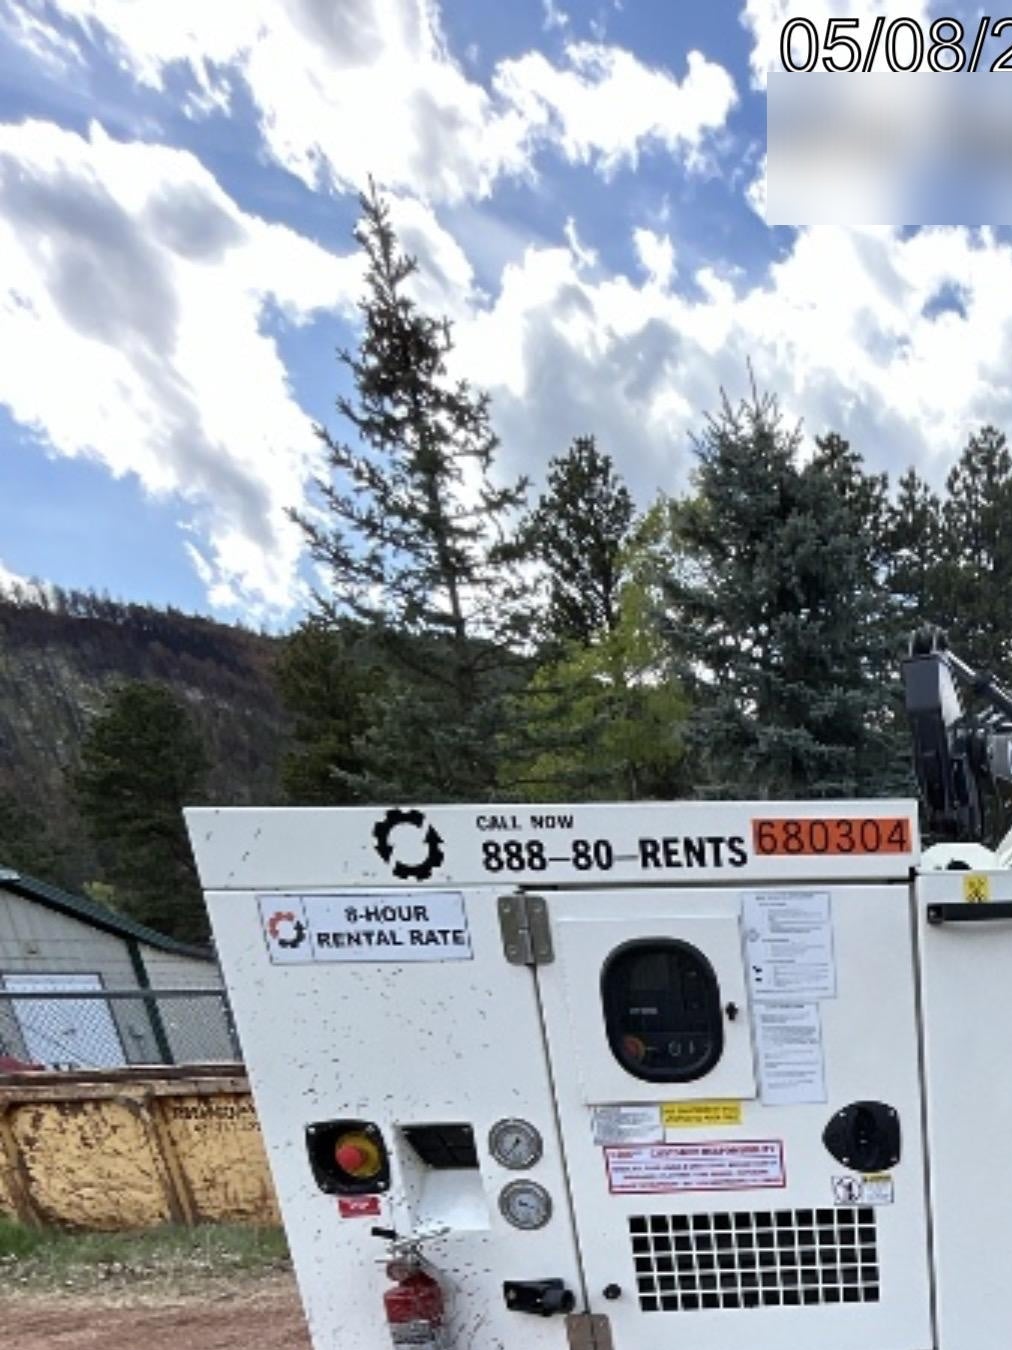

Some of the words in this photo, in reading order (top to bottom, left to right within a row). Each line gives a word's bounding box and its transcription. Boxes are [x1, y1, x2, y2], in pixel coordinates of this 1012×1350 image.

[476, 815, 521, 831] CALL
[530, 815, 574, 829] NOW
[757, 819, 907, 854] 680304
[344, 905, 429, 923] 8-HOUR
[317, 930, 404, 948] RENTAL
[409, 929, 466, 946] RATE
